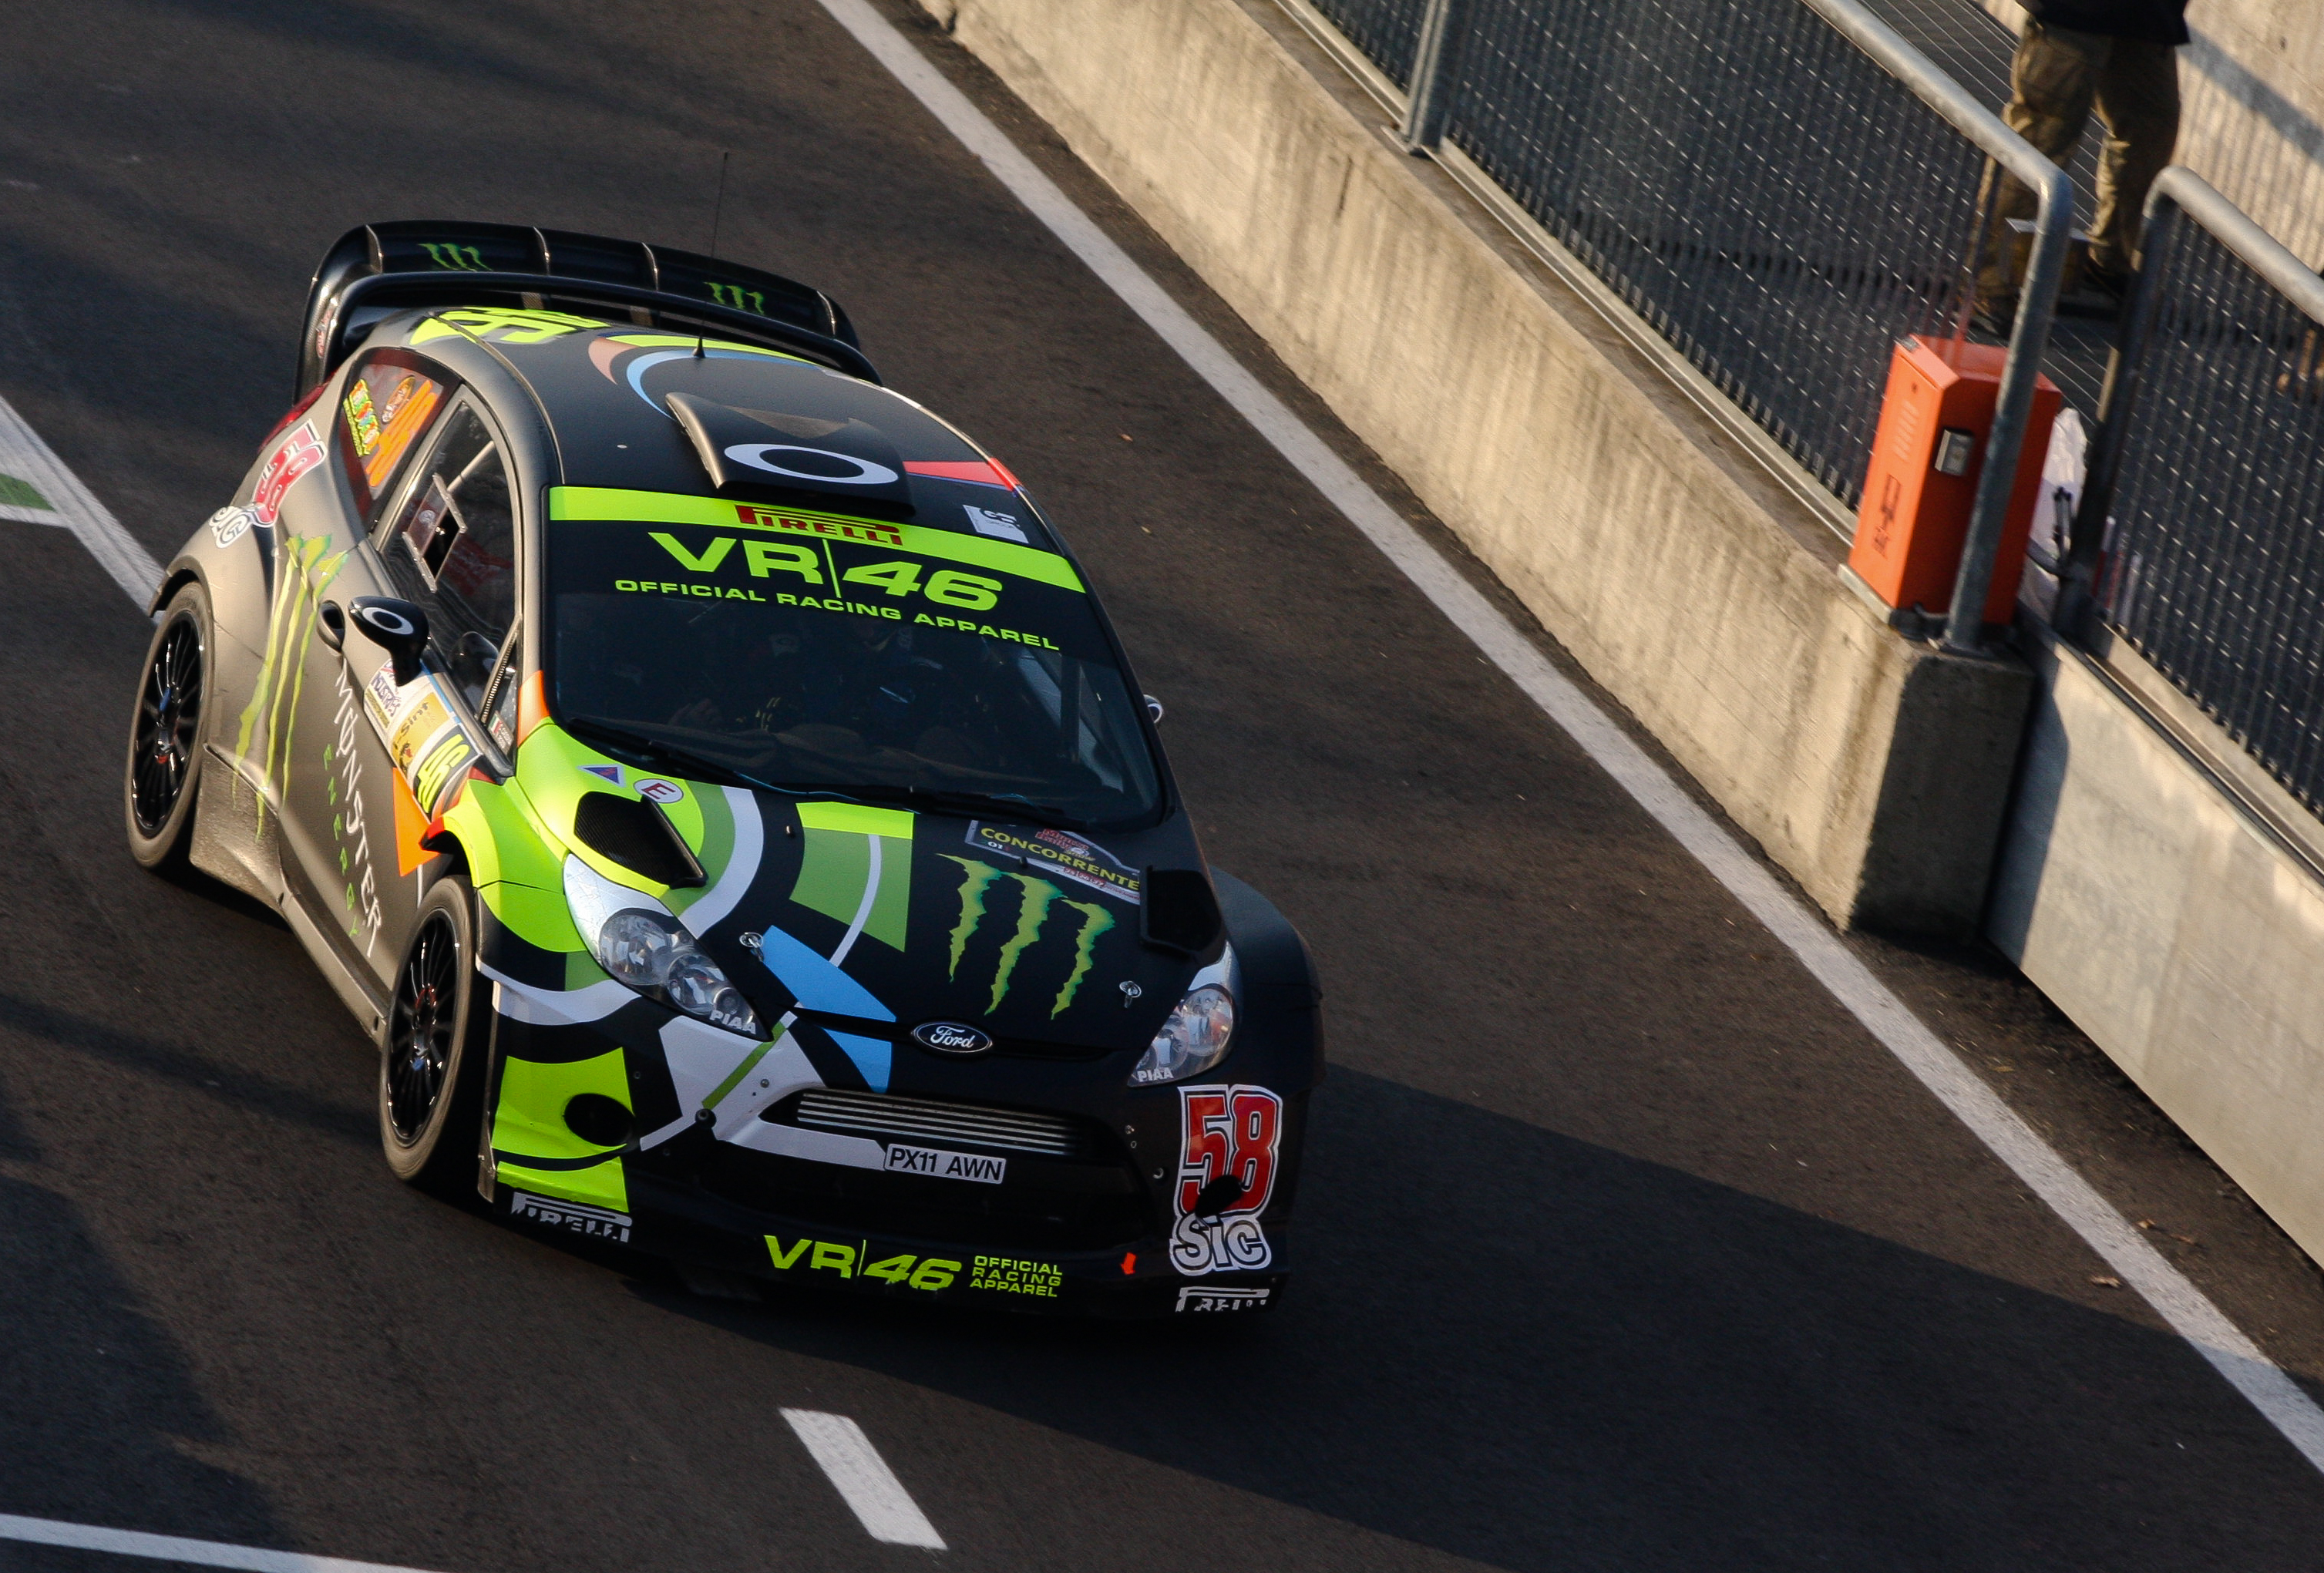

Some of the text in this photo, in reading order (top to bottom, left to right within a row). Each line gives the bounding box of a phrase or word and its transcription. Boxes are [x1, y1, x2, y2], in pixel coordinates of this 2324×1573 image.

[735, 505, 903, 546] PIRELLI
[614, 580, 1060, 650] OFFICIAL RACING APPAREL
[980, 827, 1140, 891] CONCORRENTE
[930, 1025, 976, 1048] Ford
[1137, 1067, 1174, 1082] PIAA
[889, 1148, 1003, 1181] PX11 AWN
[1179, 1087, 1280, 1215] 58
[973, 1267, 1061, 1286] RACING
[974, 1255, 1063, 1276] OFFICIAL
[970, 1279, 1058, 1298] APPAREL
